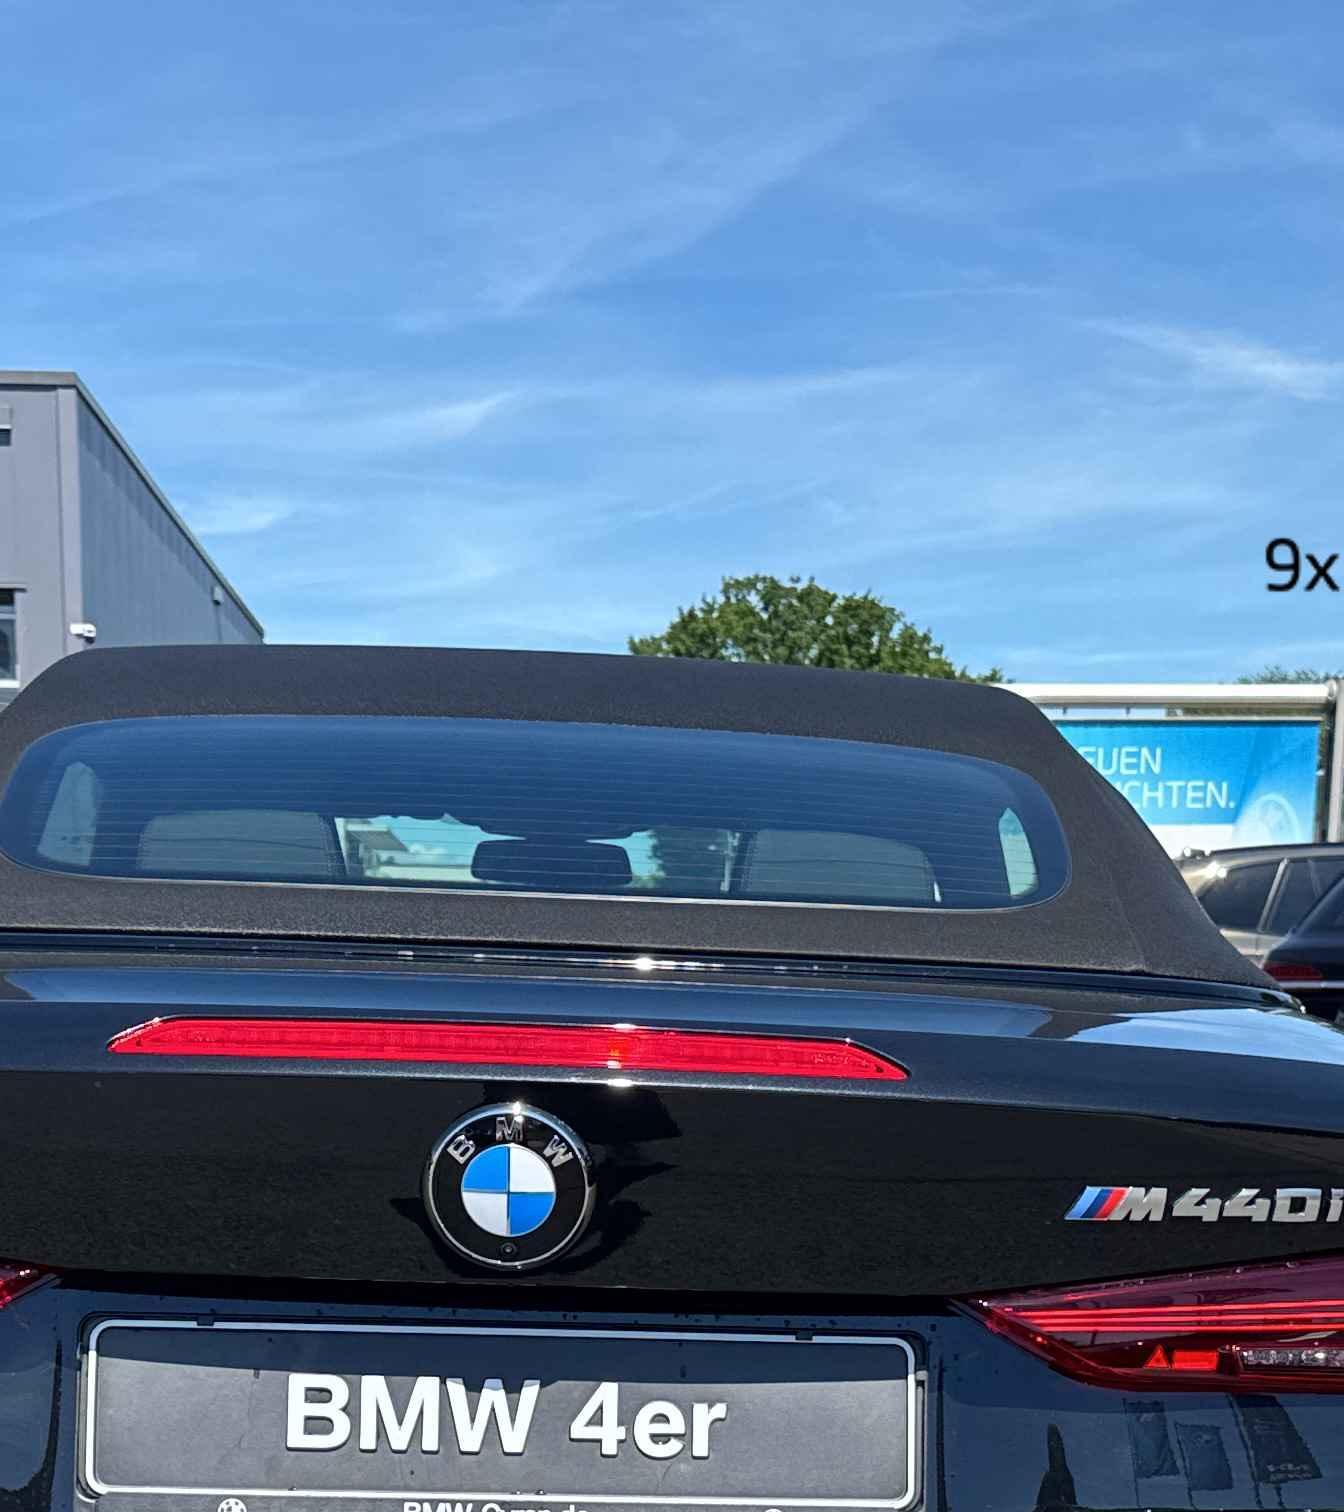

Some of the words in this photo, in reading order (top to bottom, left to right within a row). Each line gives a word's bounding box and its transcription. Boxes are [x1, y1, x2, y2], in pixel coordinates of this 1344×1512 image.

[447, 1116, 573, 1167] BMW
[1102, 1186, 1344, 1222] M440i
[286, 1372, 541, 1455] BMW
[569, 1382, 729, 1460] 4er
